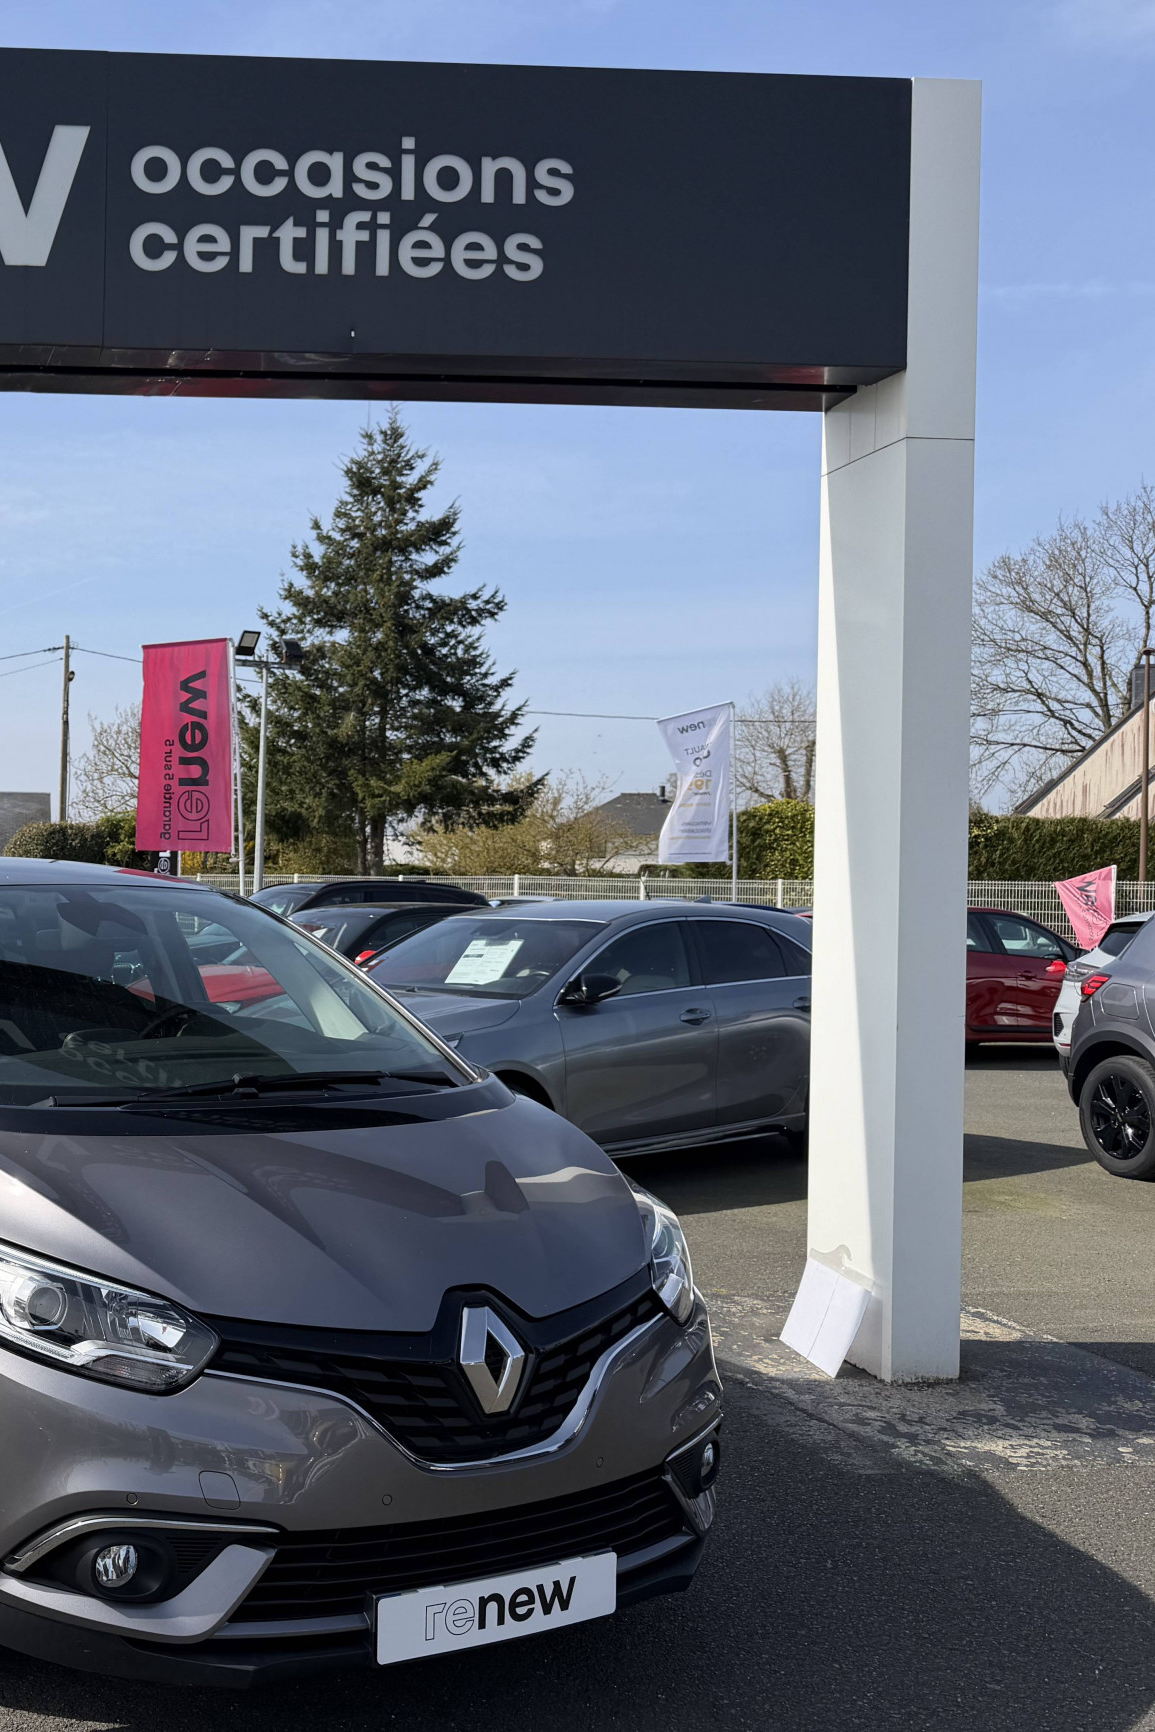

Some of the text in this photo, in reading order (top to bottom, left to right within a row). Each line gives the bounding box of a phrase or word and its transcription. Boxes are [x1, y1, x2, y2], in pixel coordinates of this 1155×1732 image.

[130, 136, 574, 206] occasions
[129, 209, 544, 281] certifiées
[424, 1576, 577, 1641] renew
